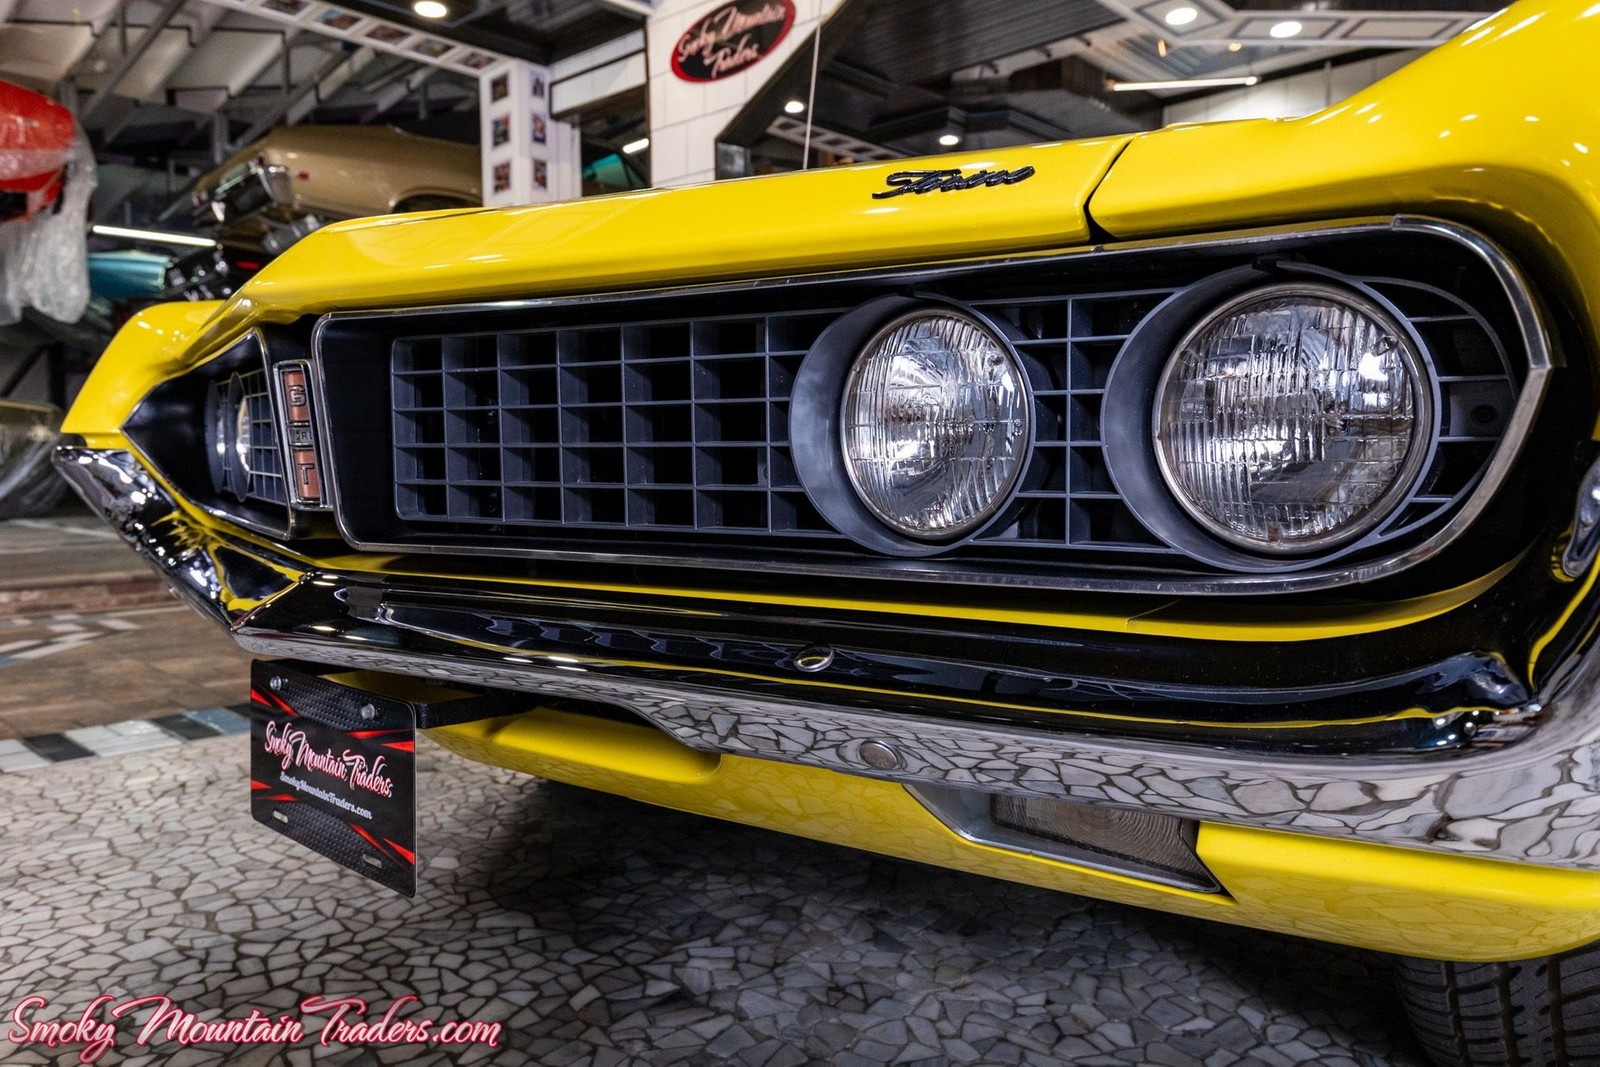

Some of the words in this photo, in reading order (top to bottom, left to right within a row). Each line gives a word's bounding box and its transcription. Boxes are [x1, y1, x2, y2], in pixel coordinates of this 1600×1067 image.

[871, 165, 1036, 200] Torino
[264, 720, 294, 770] Smoky
[289, 730, 347, 781] Mountain
[342, 749, 393, 798] Traders
[279, 770, 373, 820] SmokyMountainTraders.com
